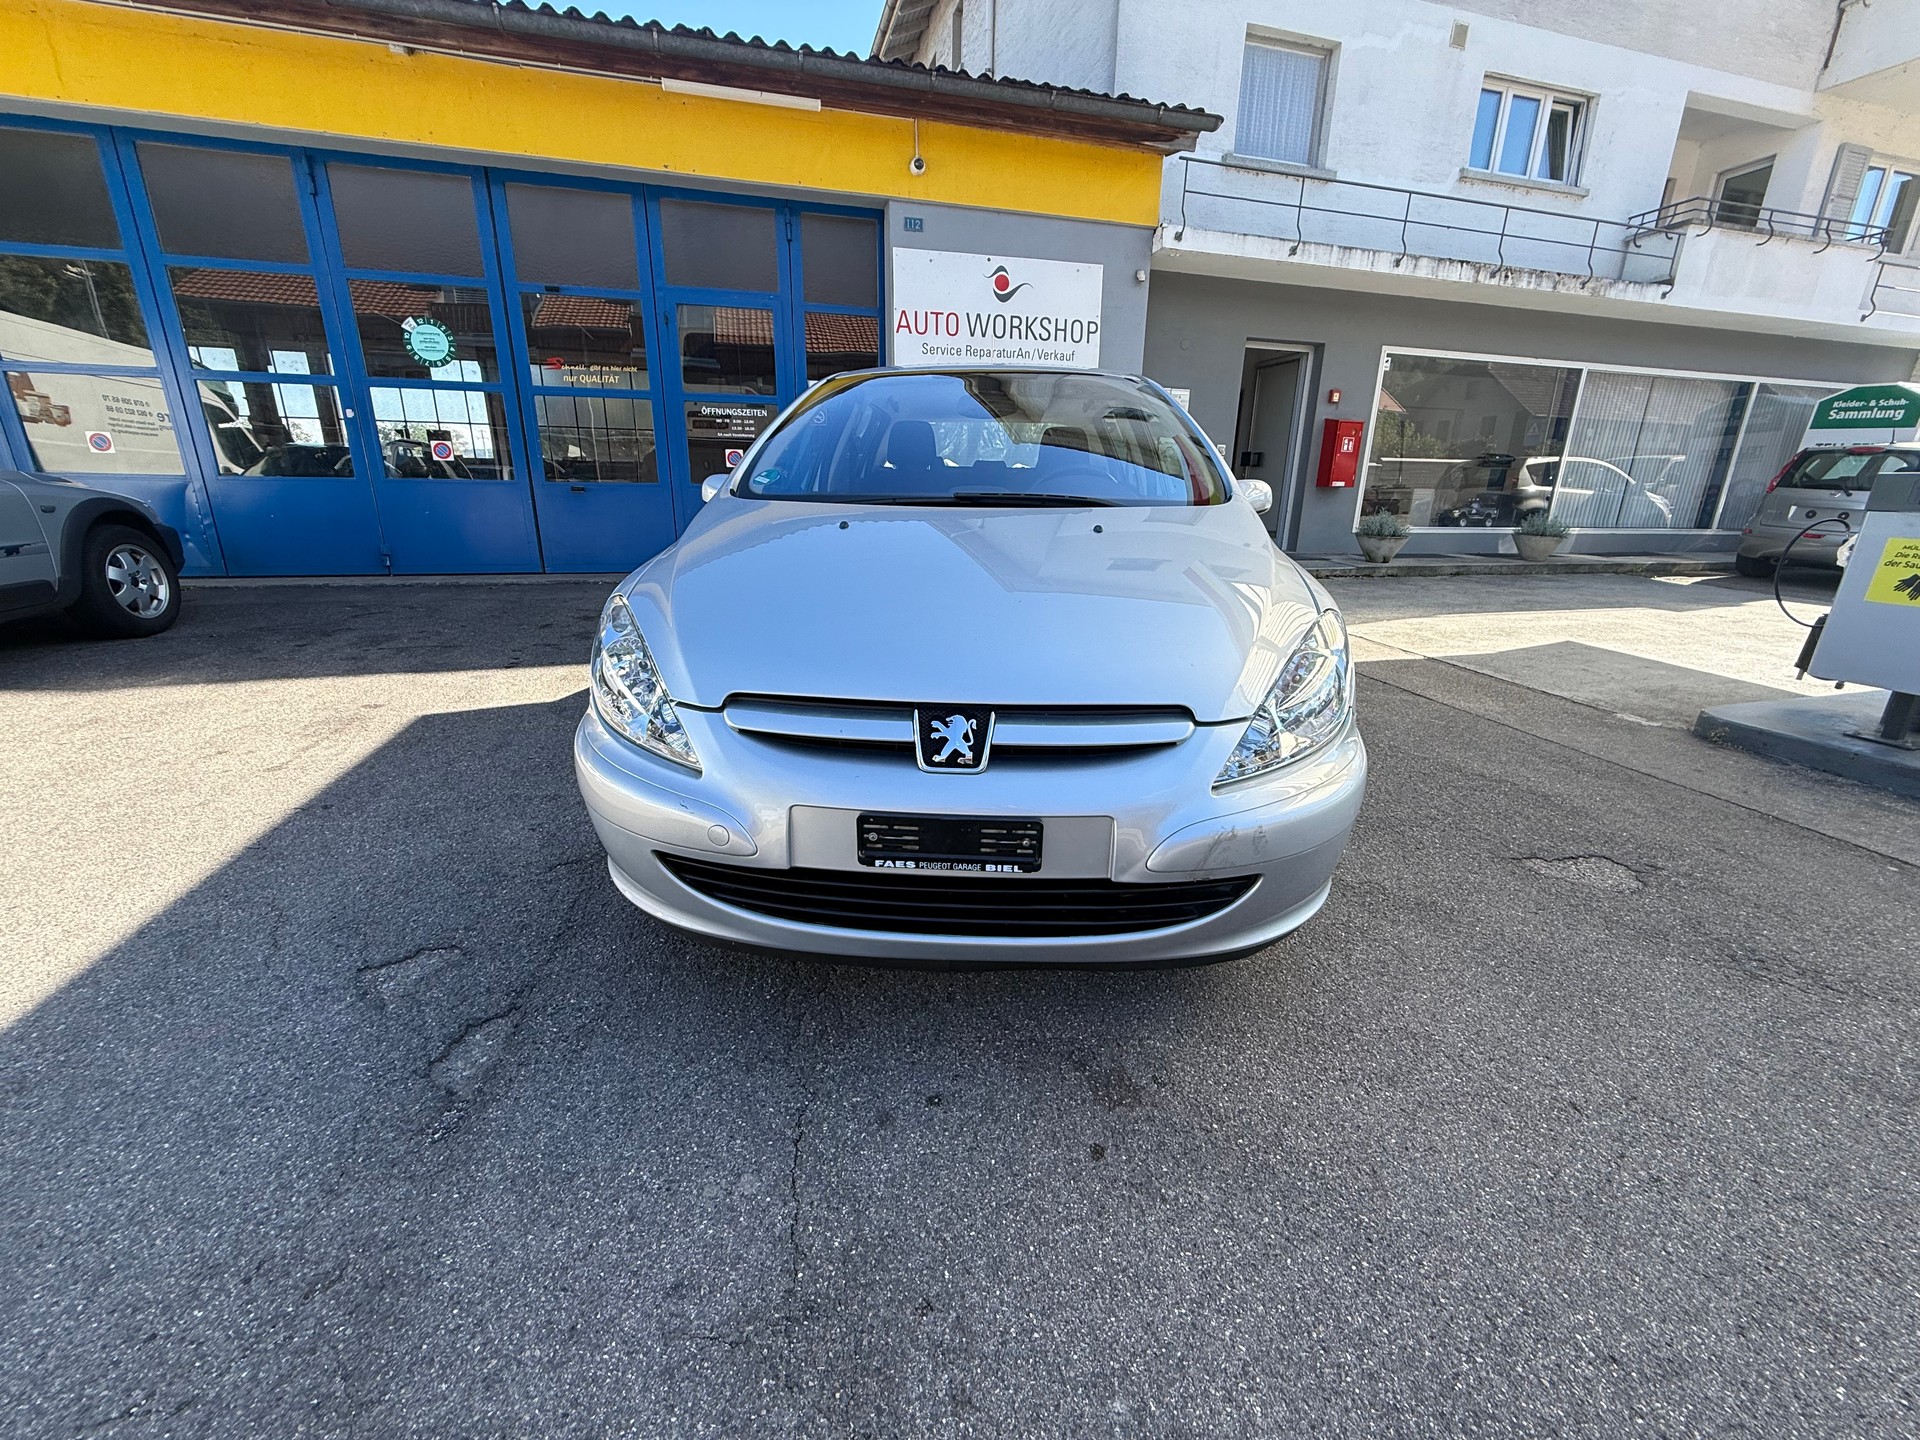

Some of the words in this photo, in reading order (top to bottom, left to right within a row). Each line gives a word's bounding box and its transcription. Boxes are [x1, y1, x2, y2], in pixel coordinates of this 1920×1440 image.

[906, 219, 921, 230] 112
[896, 309, 960, 337] AUTO
[965, 312, 1099, 344] WORKSHOP
[921, 342, 962, 357] Service
[965, 344, 1076, 362] ReparaturAn/Verkauf
[545, 357, 587, 371] Schnell
[579, 373, 620, 384] QUALITÄT
[1832, 400, 1867, 408] Kleider-
[1878, 398, 1910, 406] Schuh-
[701, 405, 768, 417] ÖFFNUNGSZEITEN
[1828, 407, 1905, 420] Sammlung
[1884, 559, 1902, 567] der
[1903, 560, 1920, 569] Sau
[874, 860, 916, 869] FAES
[919, 861, 951, 870] PEUGEOT
[952, 863, 982, 871] GARAGE
[985, 864, 1023, 873] BIEL
